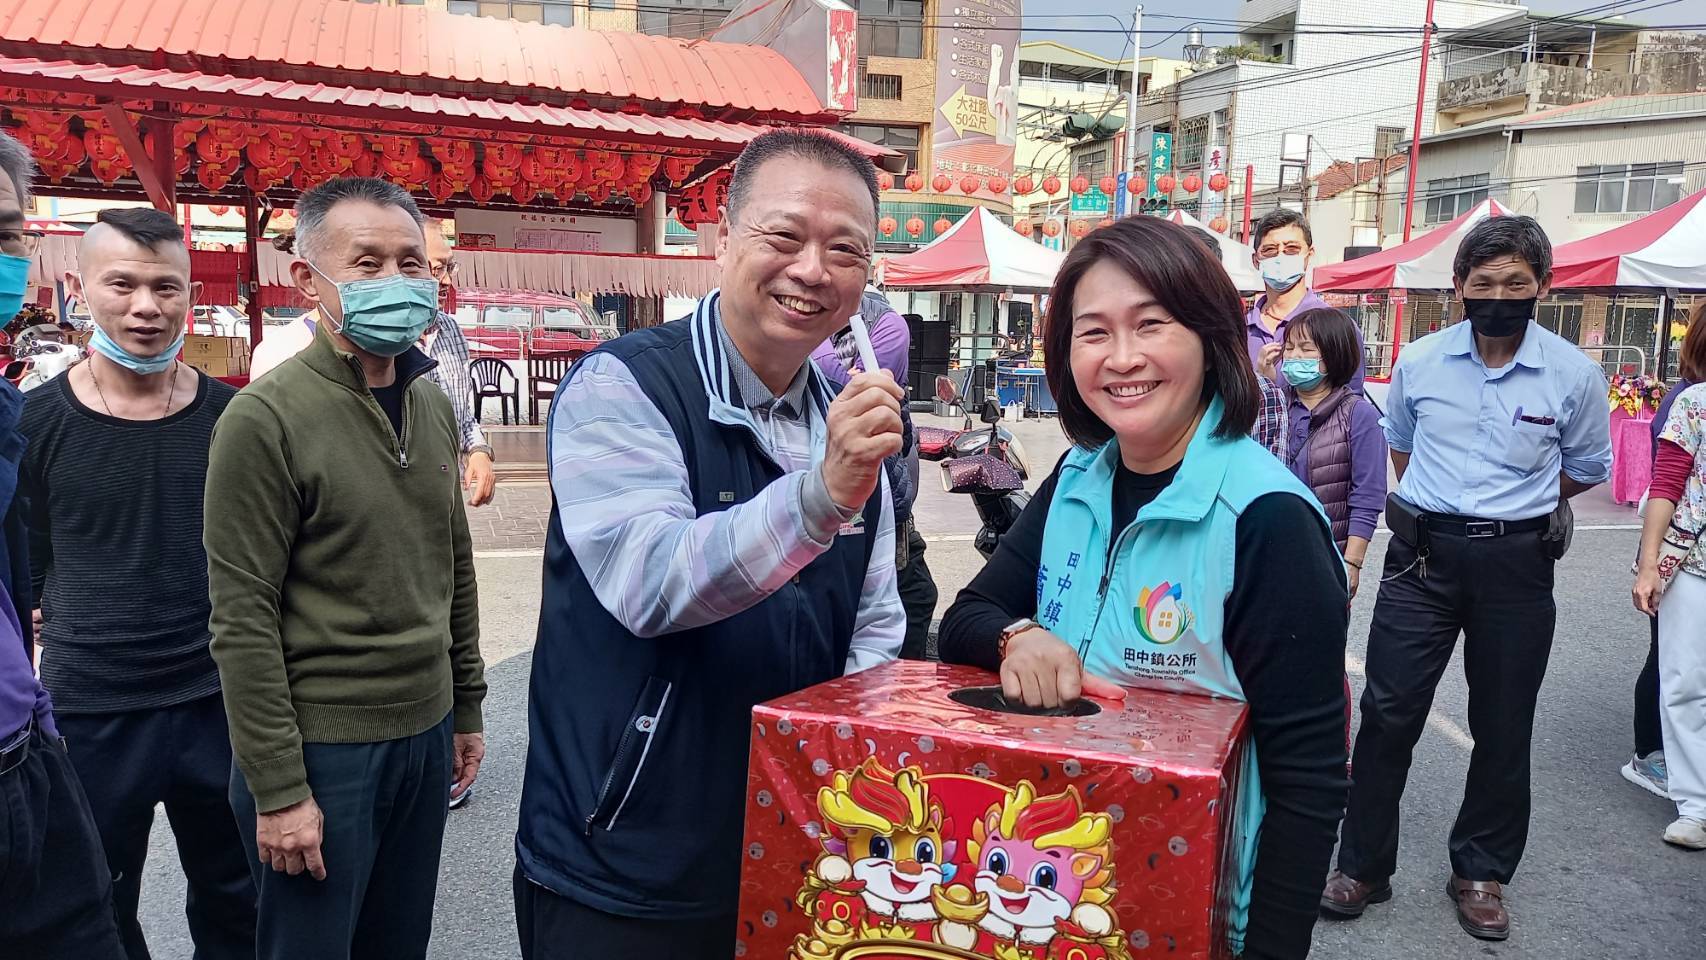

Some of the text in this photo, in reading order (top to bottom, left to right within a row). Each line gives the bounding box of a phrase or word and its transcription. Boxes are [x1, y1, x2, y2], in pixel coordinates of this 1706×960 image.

[957, 96, 987, 115] 大社路
[955, 113, 988, 131] 50公尺
[1043, 551, 1081, 631] 田中鎮
[1124, 647, 1197, 667] 田中鎮公所
